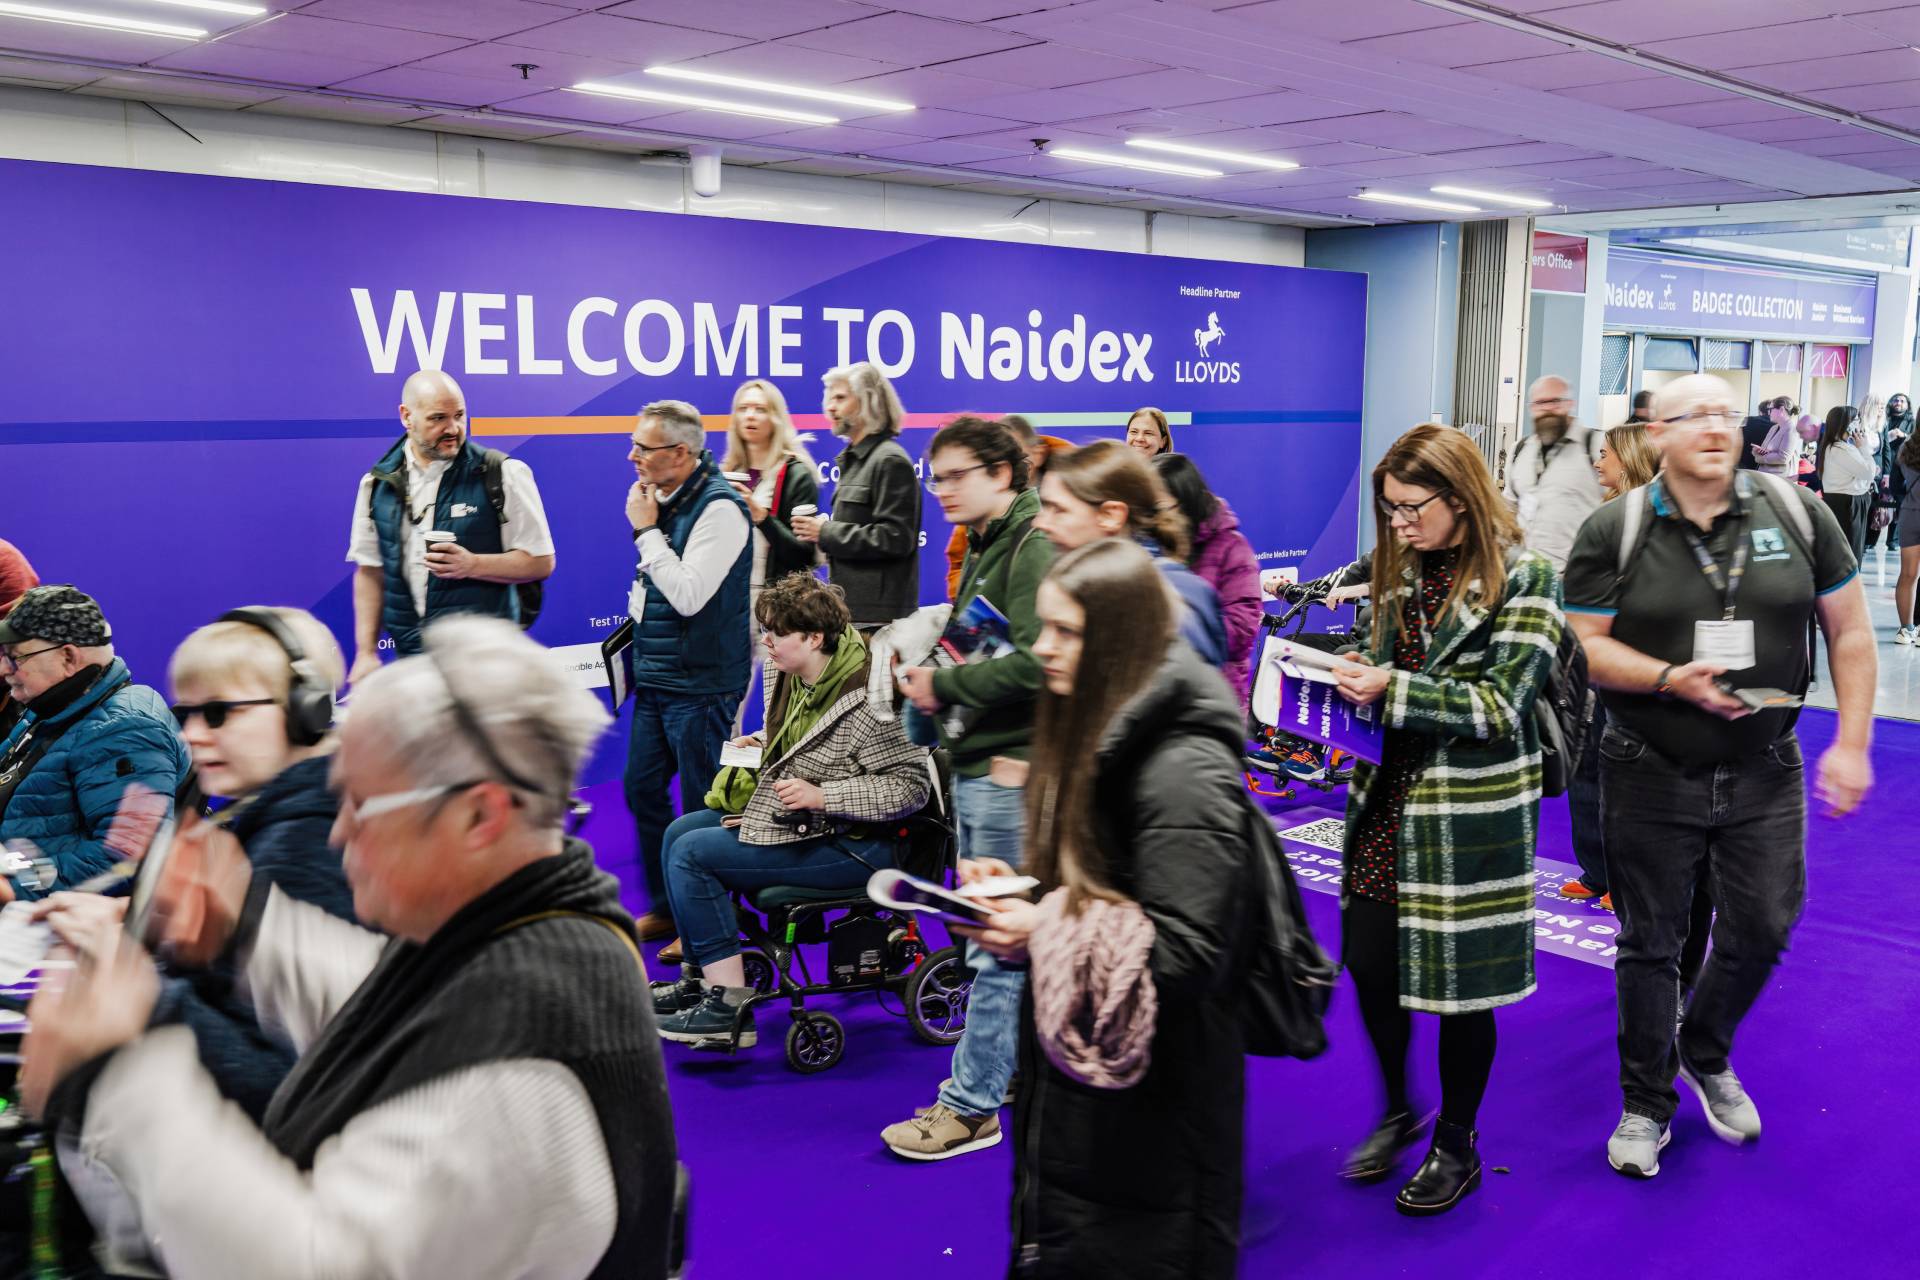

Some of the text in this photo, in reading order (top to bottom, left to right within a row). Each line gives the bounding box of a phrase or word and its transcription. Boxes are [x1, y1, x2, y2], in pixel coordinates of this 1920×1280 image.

[1548, 252, 1573, 269] Office
[1180, 286, 1241, 299] Headline Partner
[1605, 281, 1654, 309] Naidex
[1692, 290, 1803, 320] BADGE COLLECTION
[351, 288, 1154, 383] WELCOME TO Naidex
[1175, 361, 1241, 383] LLOYDS
[1255, 549, 1308, 560] eadline Media Partner
[589, 616, 611, 628] Test
[1297, 680, 1311, 725] Naidex
[1322, 688, 1332, 715] Show
